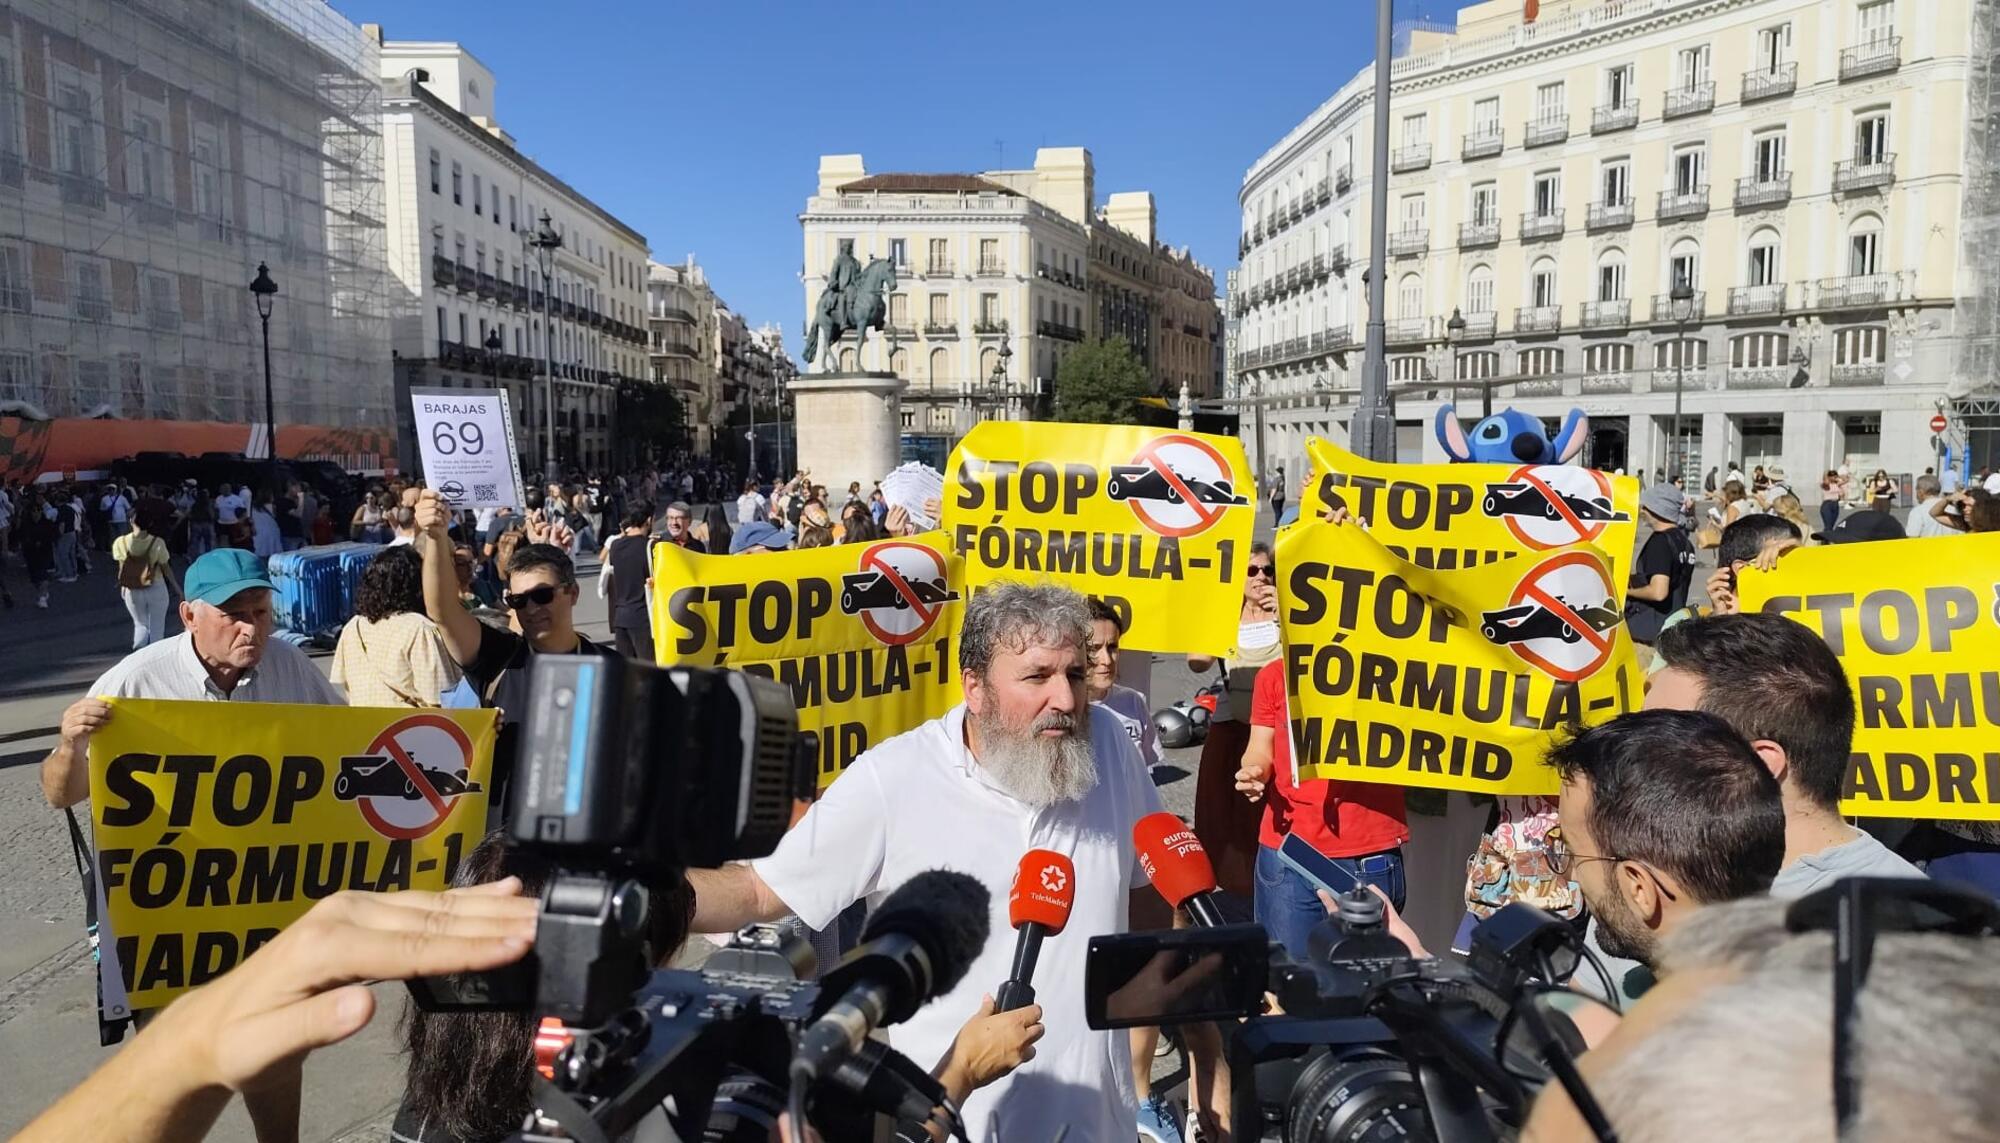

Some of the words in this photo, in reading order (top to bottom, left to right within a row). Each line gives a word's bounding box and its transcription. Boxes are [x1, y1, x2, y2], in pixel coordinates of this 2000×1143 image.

[1226, 270, 1237, 322] HOTEL
[1225, 328, 1236, 399] MODERNO
[424, 403, 487, 415] BARAJAS
[432, 421, 484, 455] 69
[957, 459, 1099, 515] STOP
[1316, 472, 1474, 532] STOP
[956, 514, 1234, 584] FÓRMULA-1
[669, 578, 832, 656] STOP
[1289, 562, 1469, 644] STOP
[1289, 633, 1630, 731] FÓRMULA-1
[1297, 718, 1513, 782] MADRID
[101, 753, 325, 828] STOP
[99, 831, 463, 910] FÓRMULA-1
